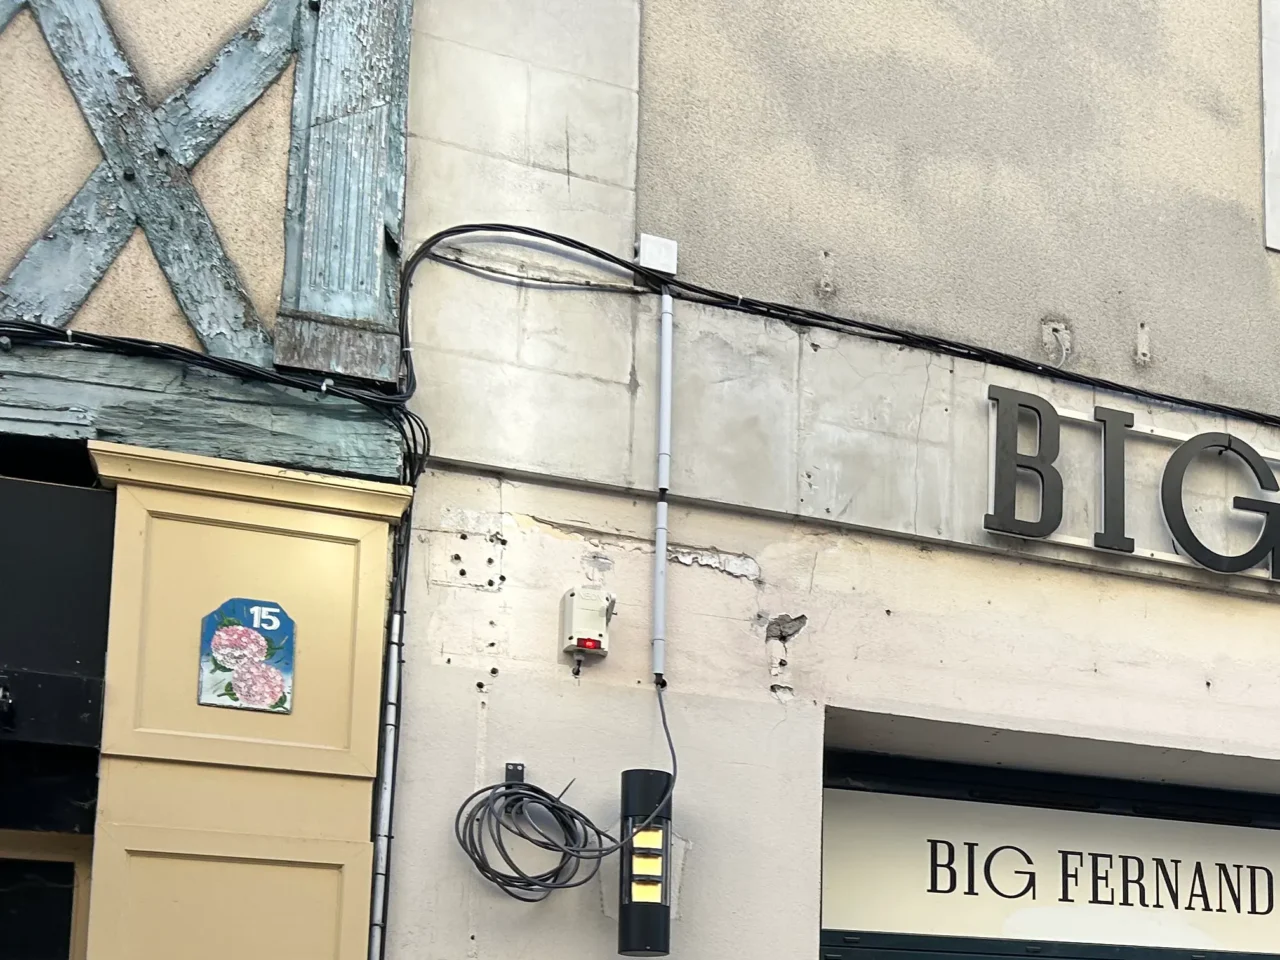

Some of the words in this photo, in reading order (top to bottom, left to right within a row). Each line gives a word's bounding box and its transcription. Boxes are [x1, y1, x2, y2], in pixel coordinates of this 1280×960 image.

[249, 605, 281, 631] 15
[926, 838, 1037, 901] BIG
[1057, 849, 1275, 916] FERNAND
